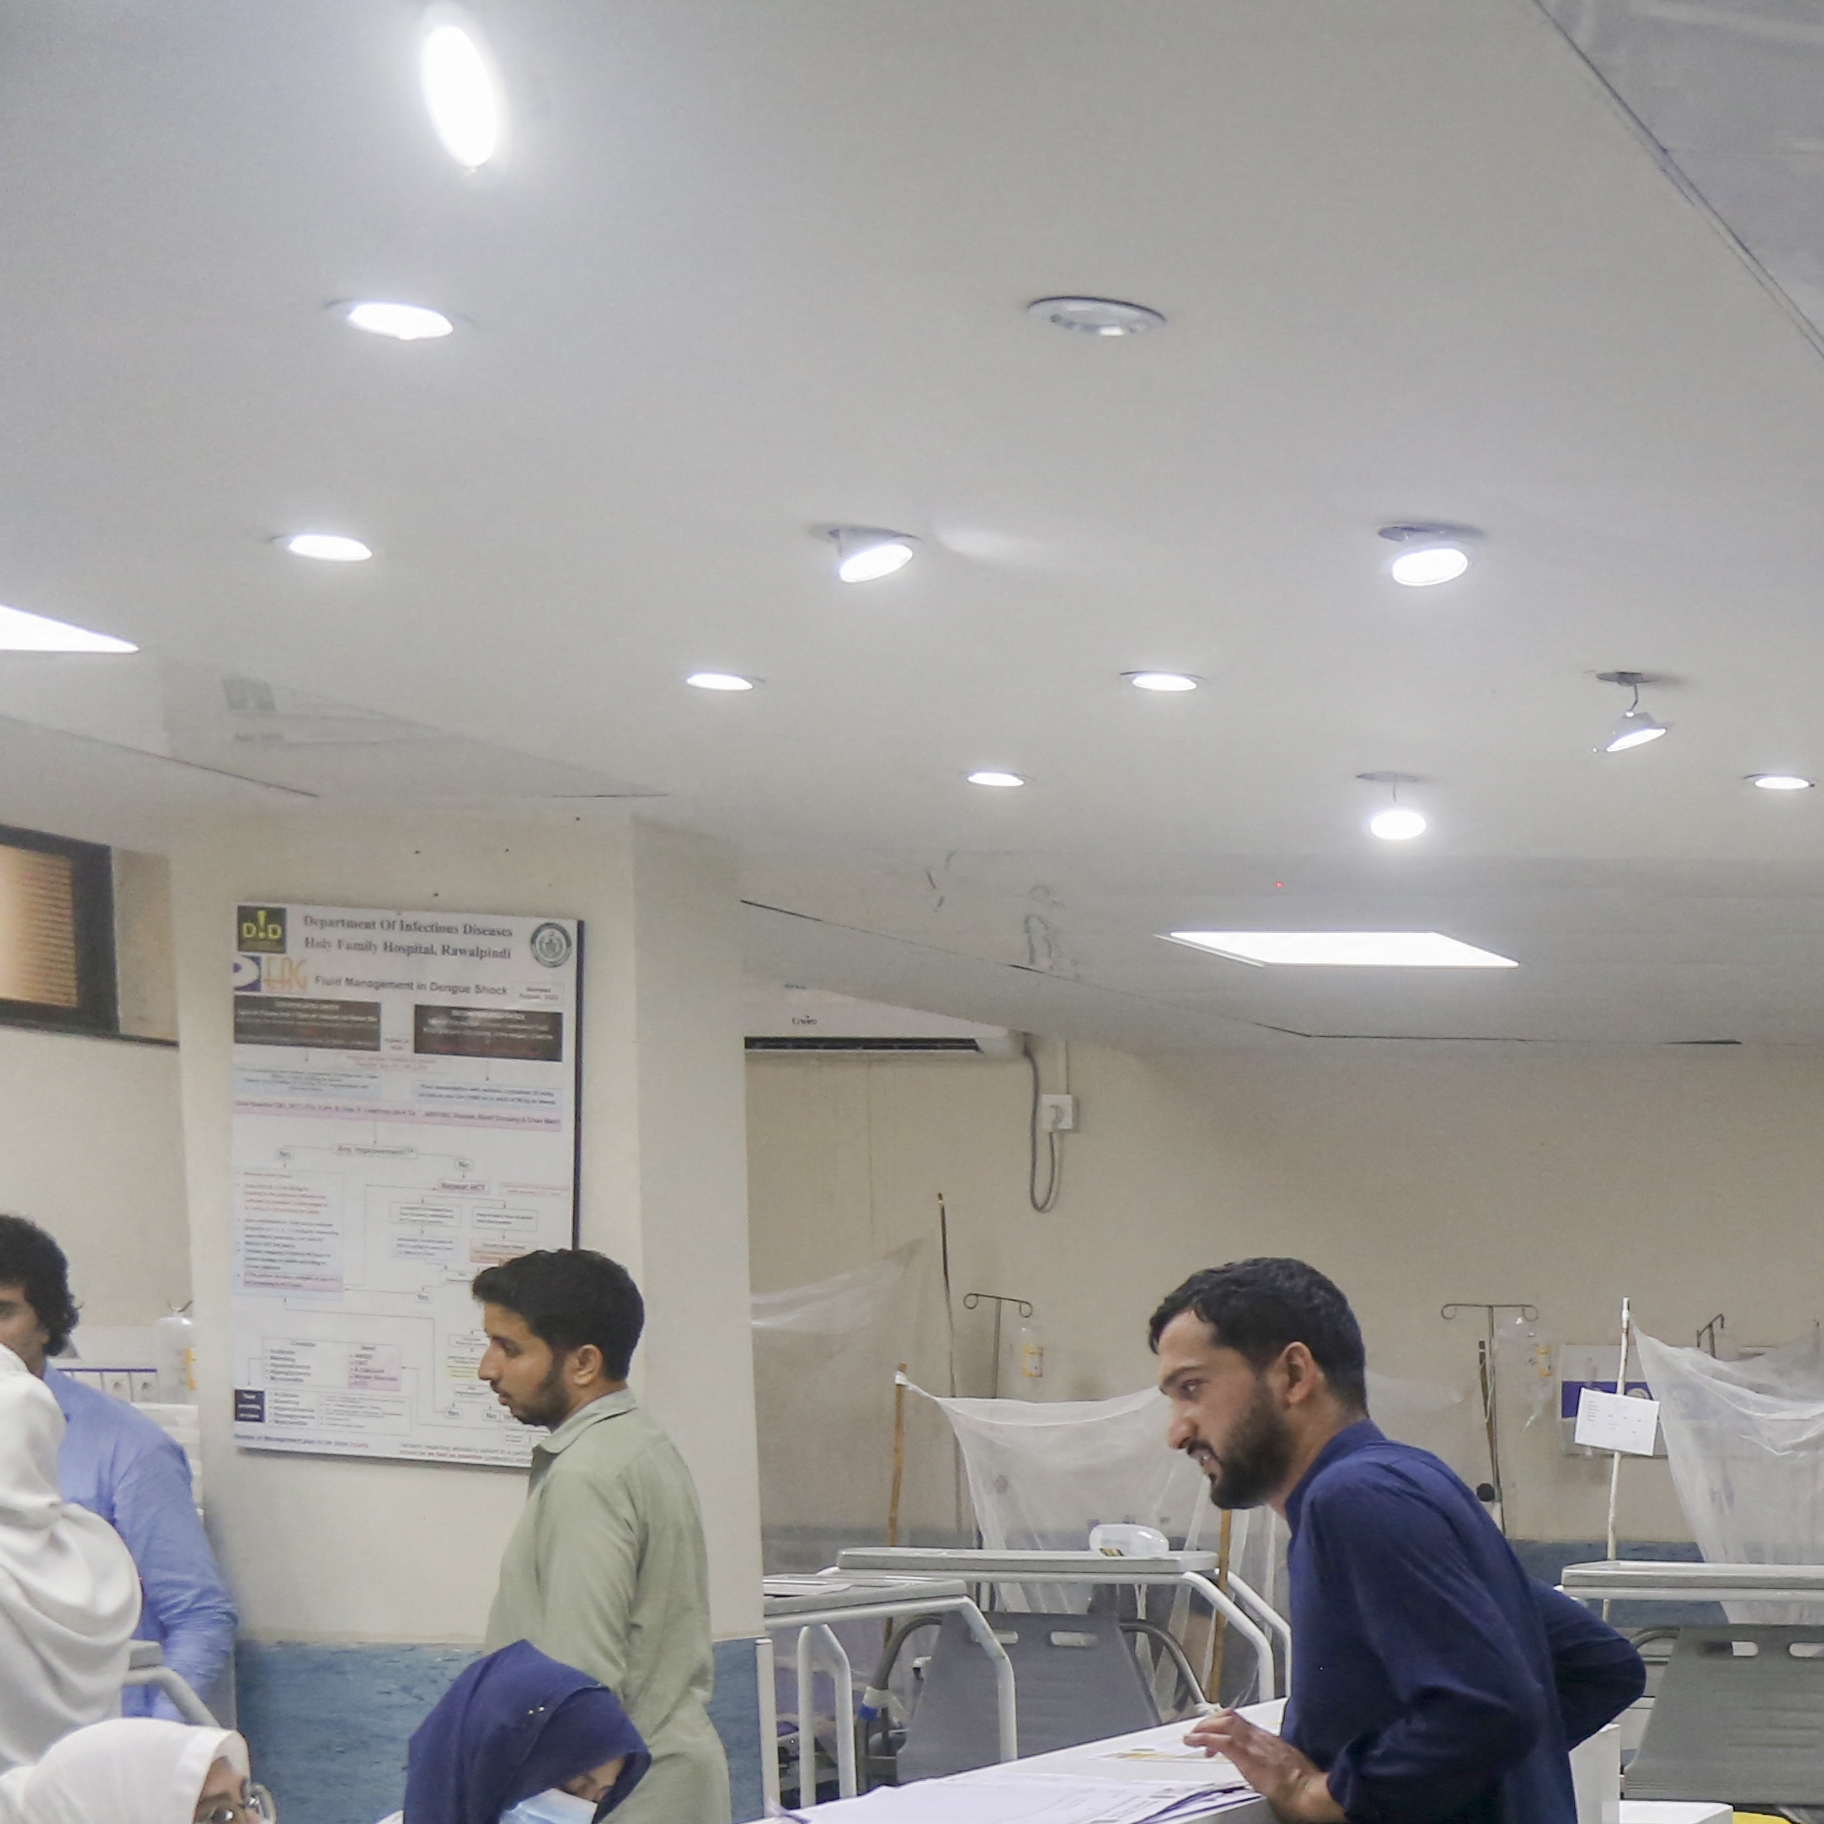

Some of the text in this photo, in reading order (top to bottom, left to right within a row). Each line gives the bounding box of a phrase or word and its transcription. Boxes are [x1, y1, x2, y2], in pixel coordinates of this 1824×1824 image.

[303, 915, 514, 938] Department Of Infectious Diseases
[305, 937, 332, 951] Holy
[337, 939, 378, 954] Family
[442, 944, 512, 960] Rawalpindi
[315, 975, 342, 987] Fluid
[345, 977, 415, 990] Management
[430, 982, 471, 995] Dengue
[475, 984, 509, 996] Shock
